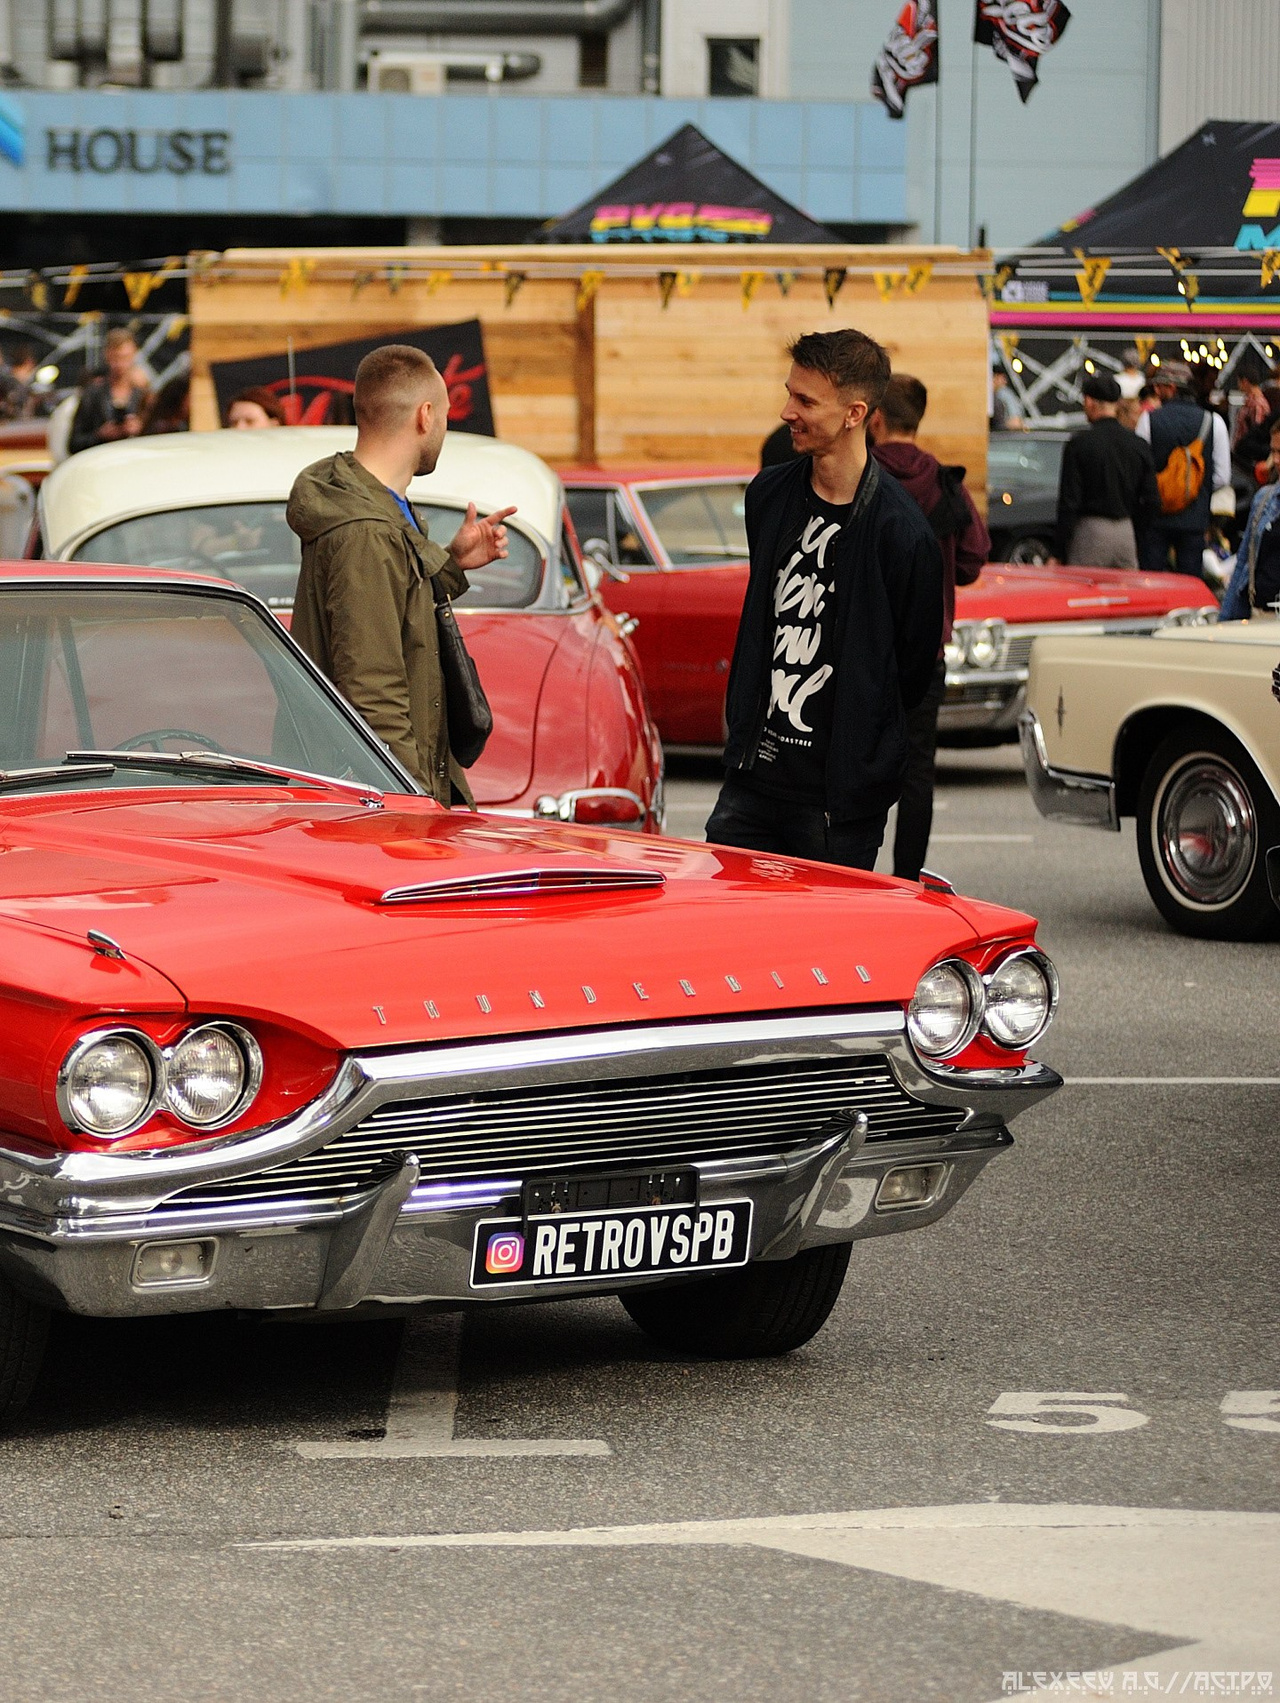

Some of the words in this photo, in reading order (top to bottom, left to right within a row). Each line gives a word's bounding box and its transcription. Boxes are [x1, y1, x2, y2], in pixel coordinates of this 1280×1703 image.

[45, 128, 232, 176] HOUSE
[372, 965, 872, 1026] THUNDERBIRD
[532, 1209, 735, 1277] RETROVSPB
